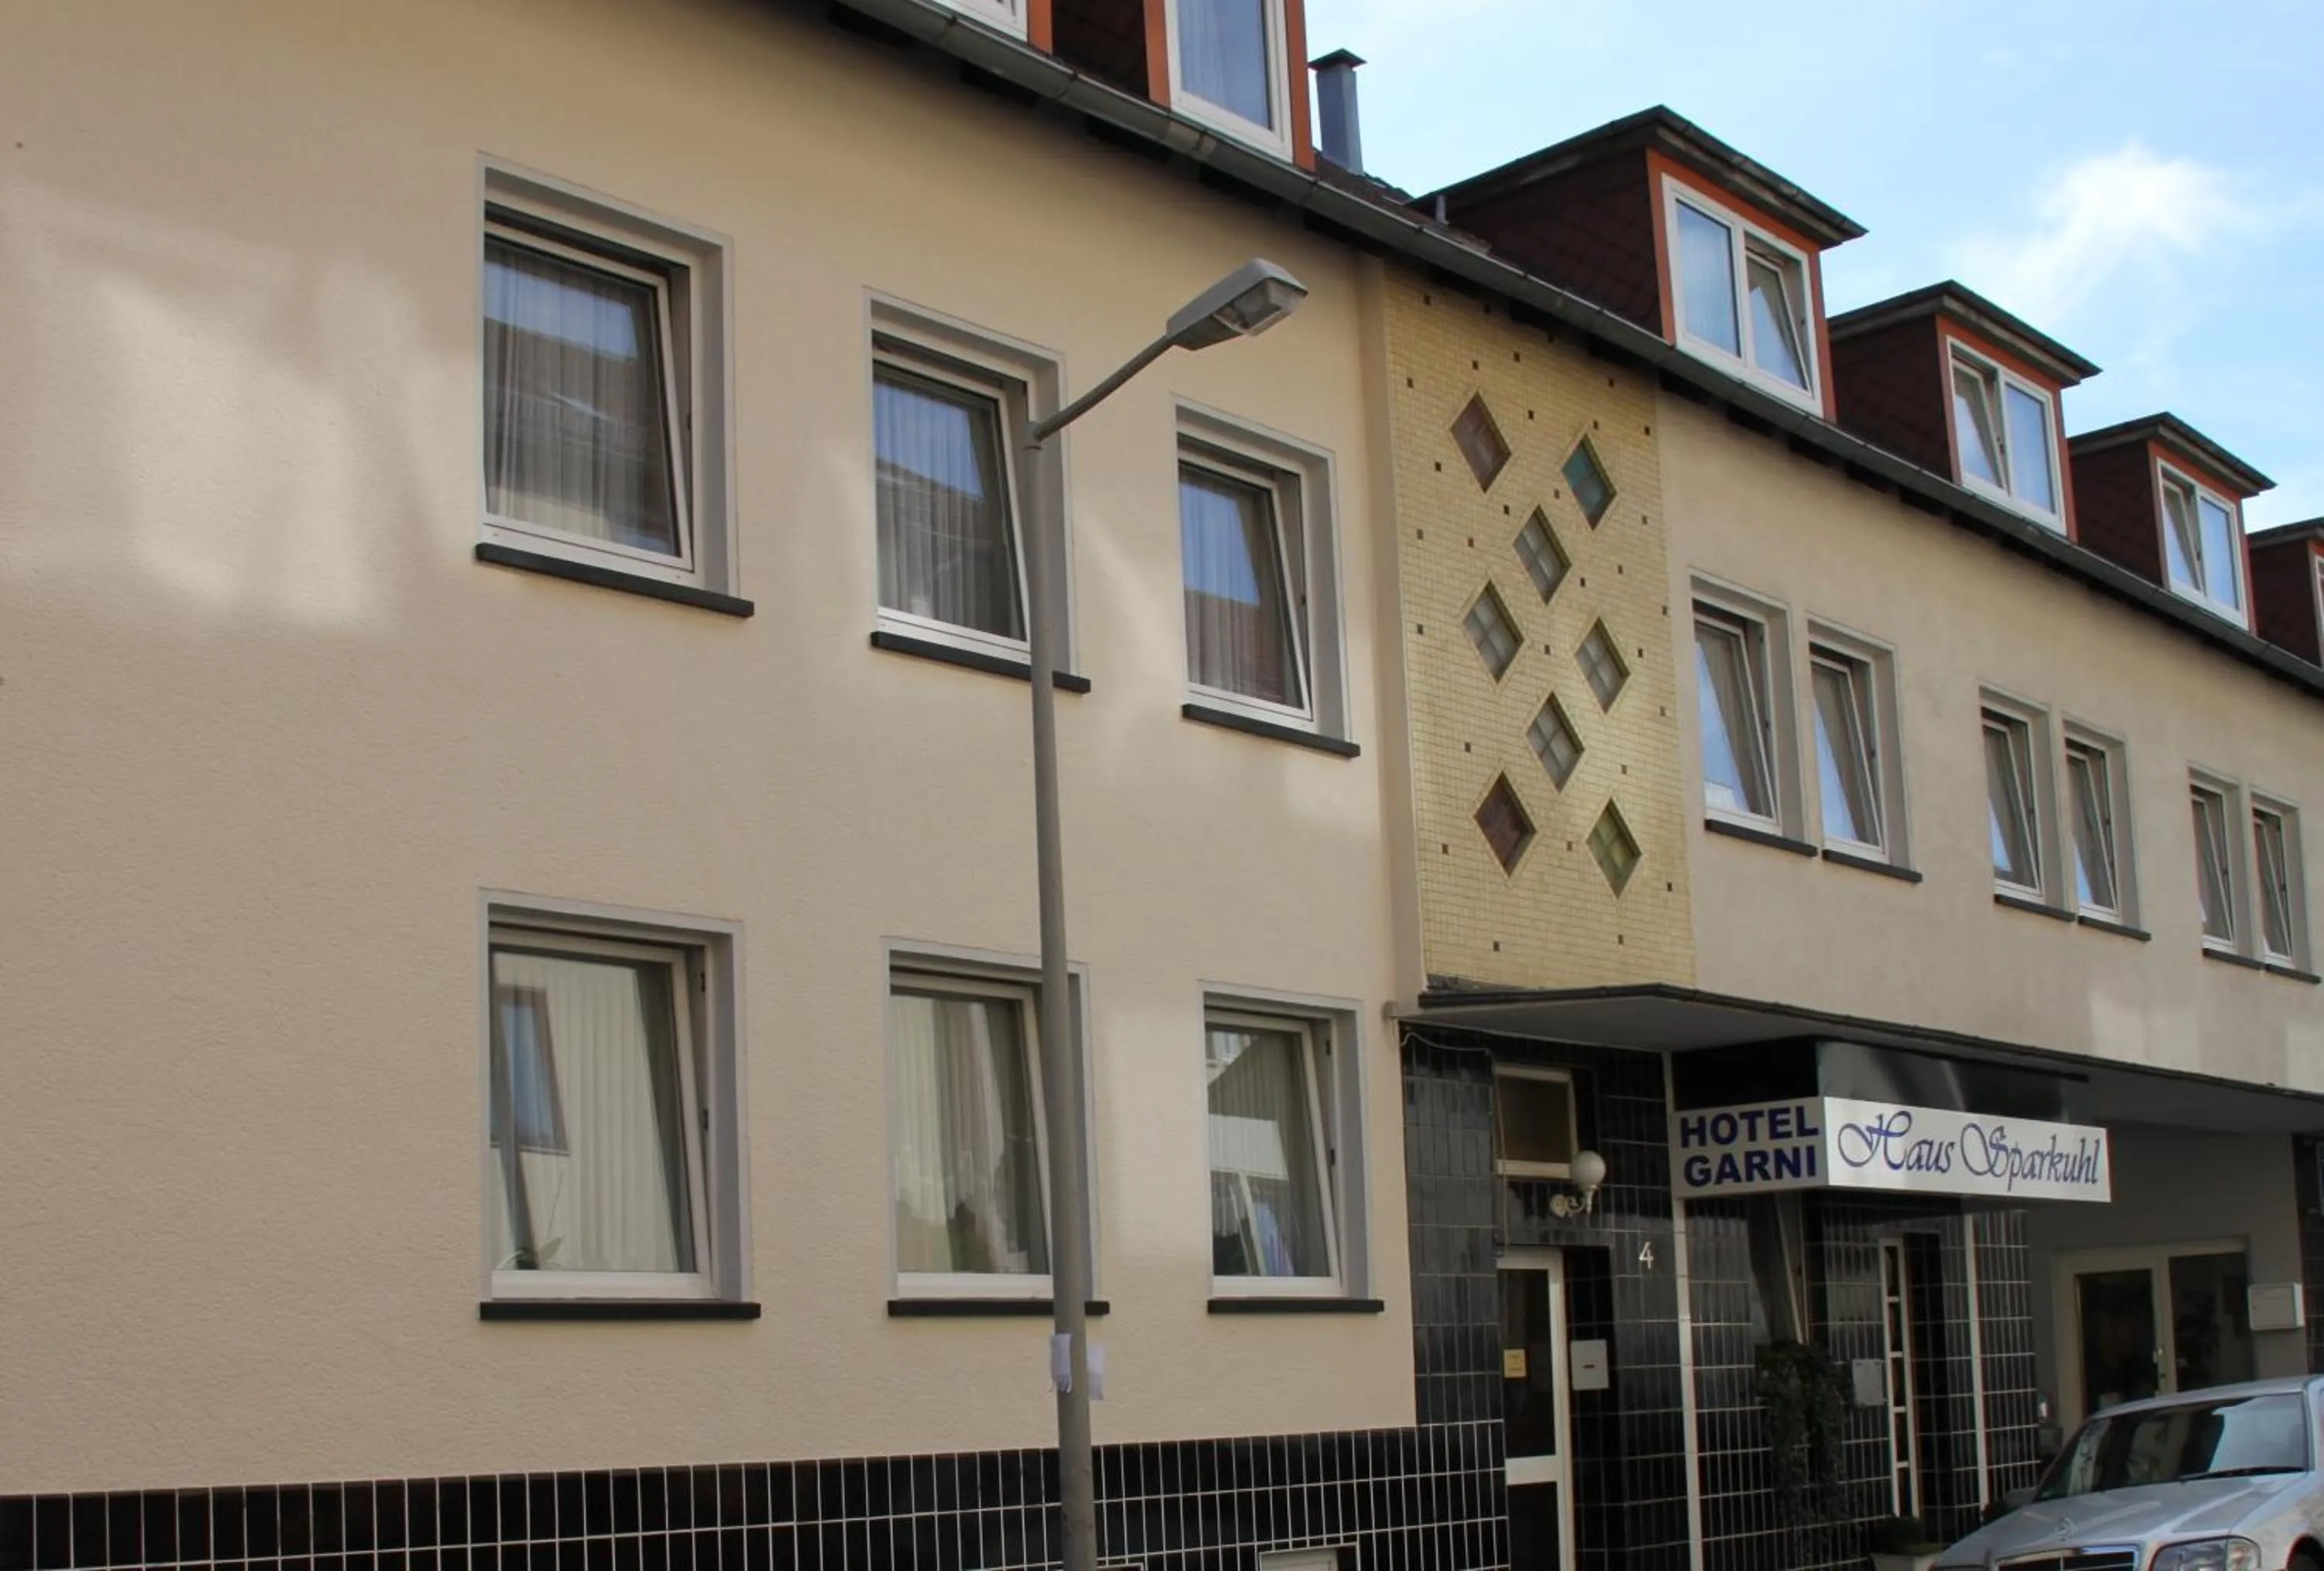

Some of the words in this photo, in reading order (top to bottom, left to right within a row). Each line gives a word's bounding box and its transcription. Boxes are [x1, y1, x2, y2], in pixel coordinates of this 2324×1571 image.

[1680, 1106, 1819, 1148] HOTEL
[1684, 1145, 1817, 1188] GARNI
[1838, 1110, 1956, 1174] Haus
[1961, 1122, 2101, 1192] Sparkuhl
[1638, 1240, 1654, 1270] 4
